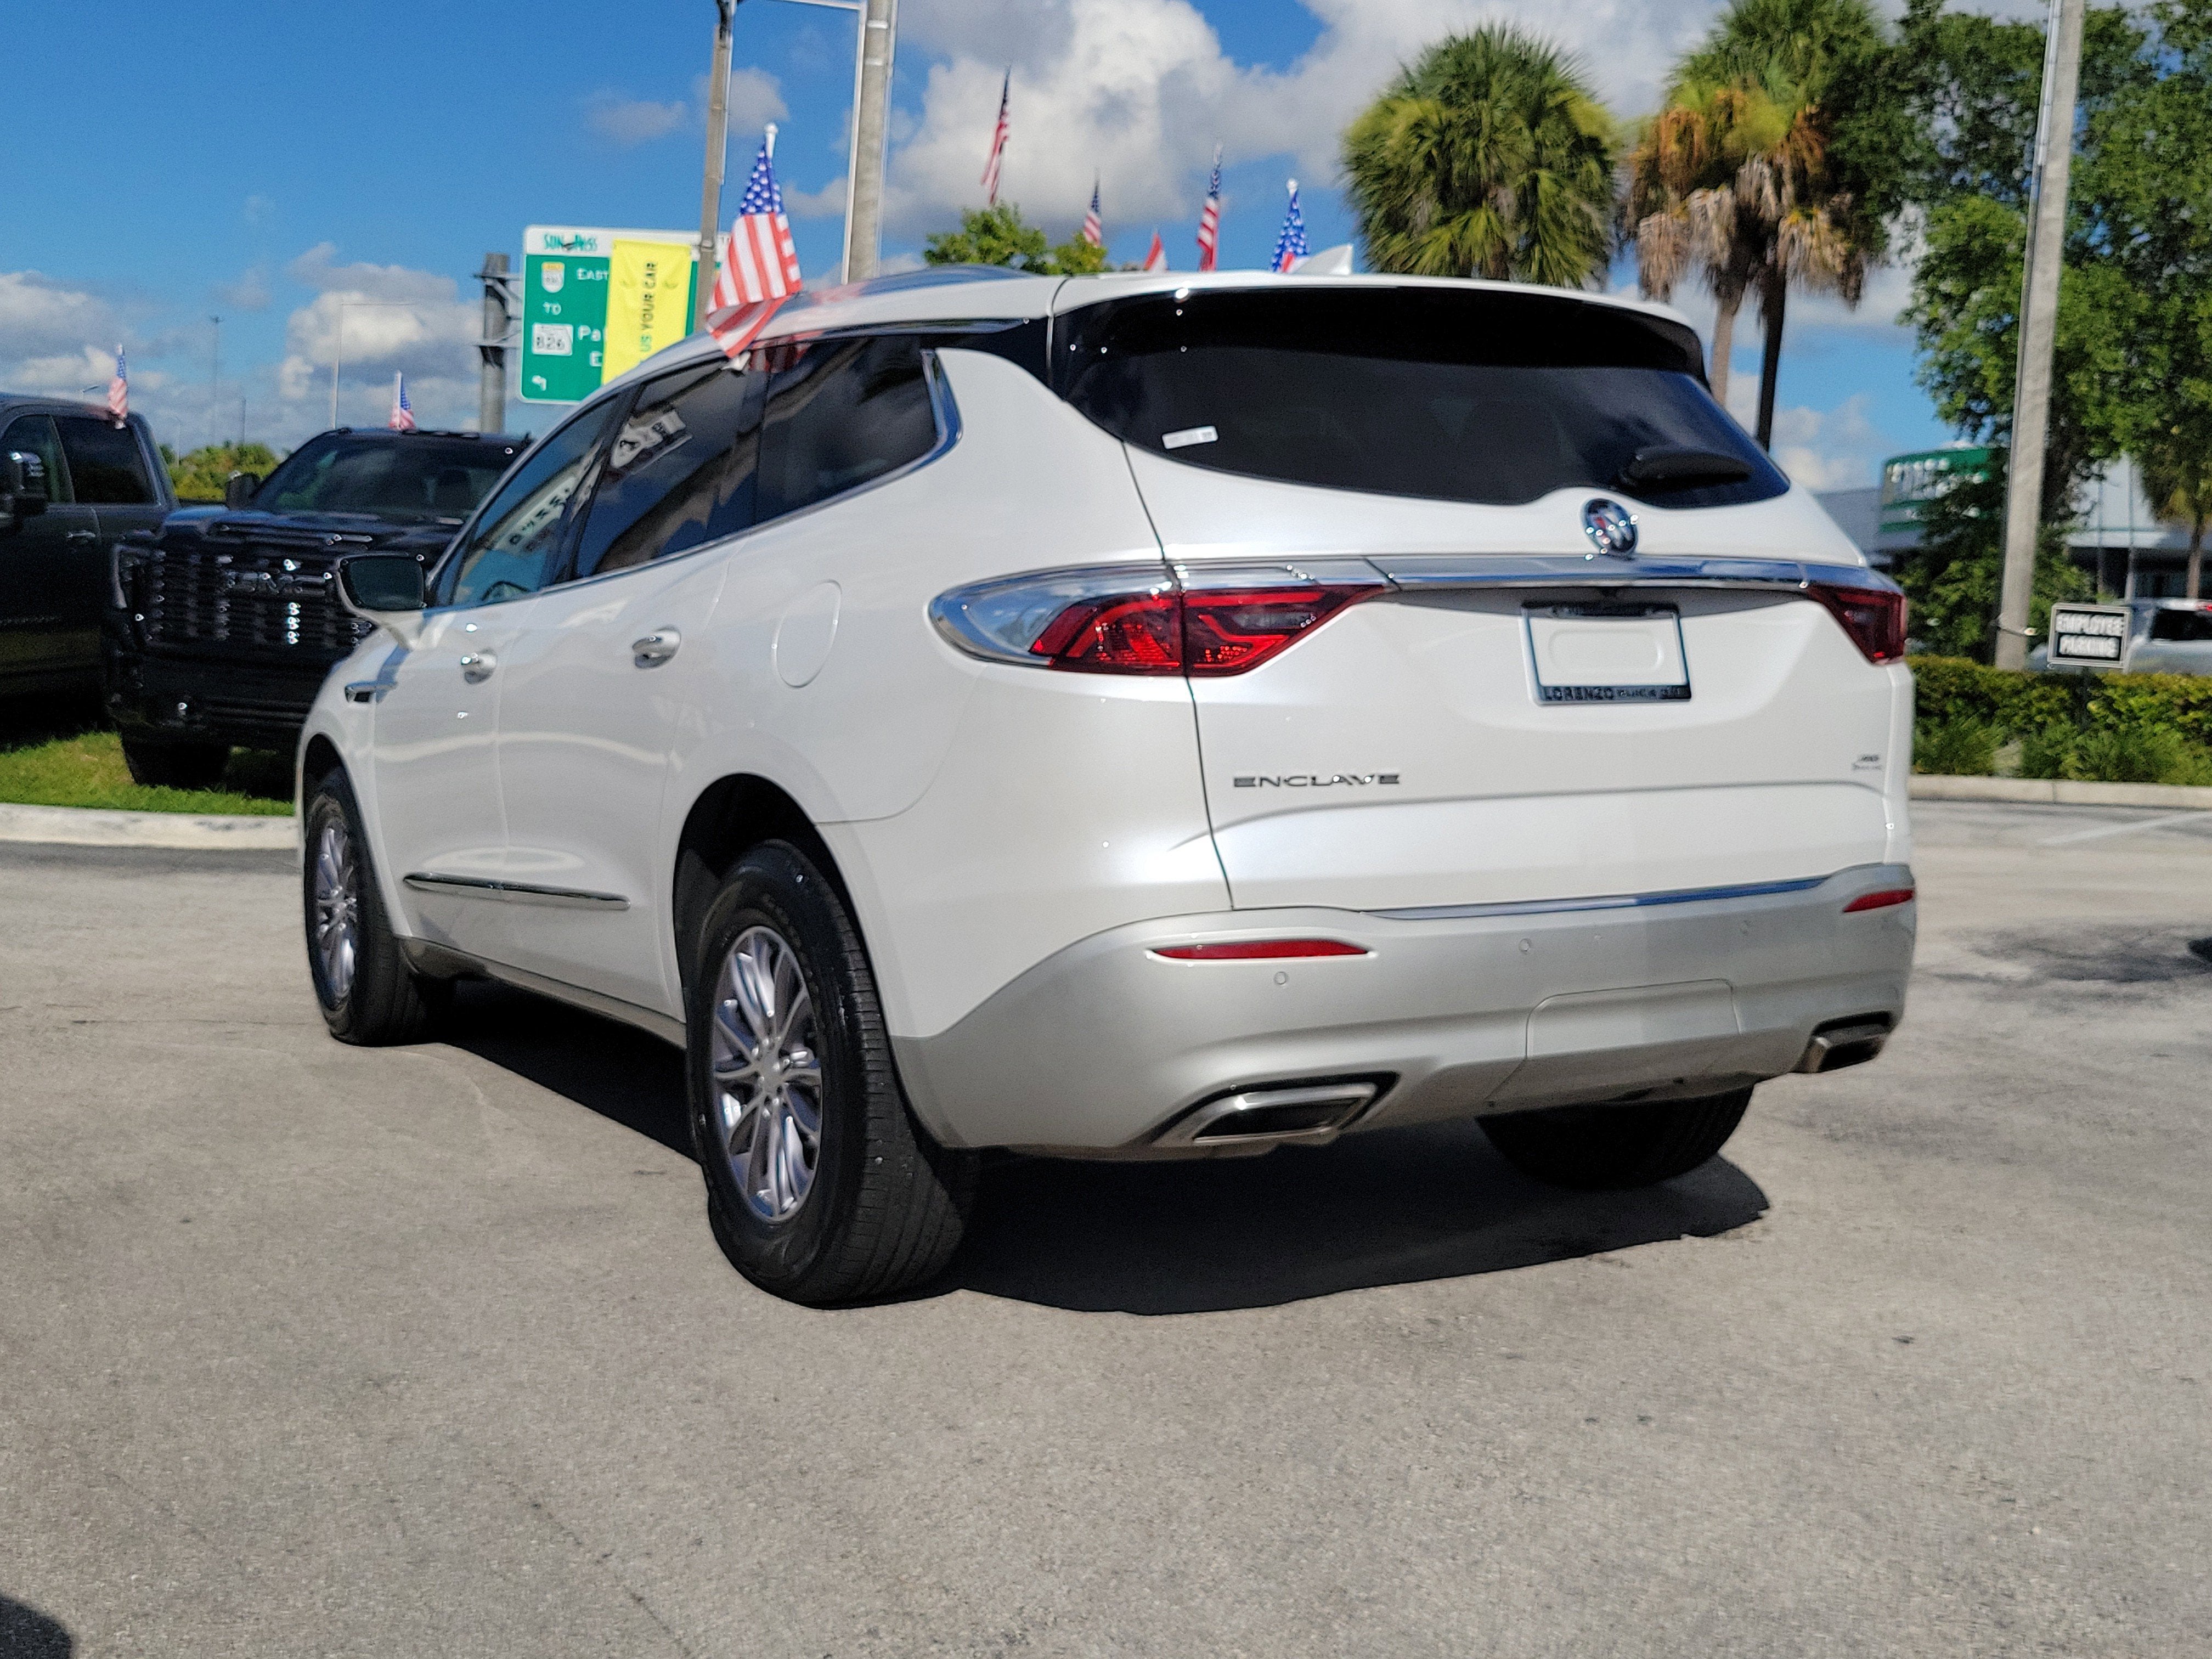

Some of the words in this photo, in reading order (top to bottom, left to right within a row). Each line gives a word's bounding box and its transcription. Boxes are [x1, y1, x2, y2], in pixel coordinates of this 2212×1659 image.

[645, 262, 658, 289] CAR
[543, 301, 562, 315] TO
[640, 294, 656, 331] YOUR
[639, 335, 652, 352] US
[1233, 774, 1399, 787] ENCLAVE
